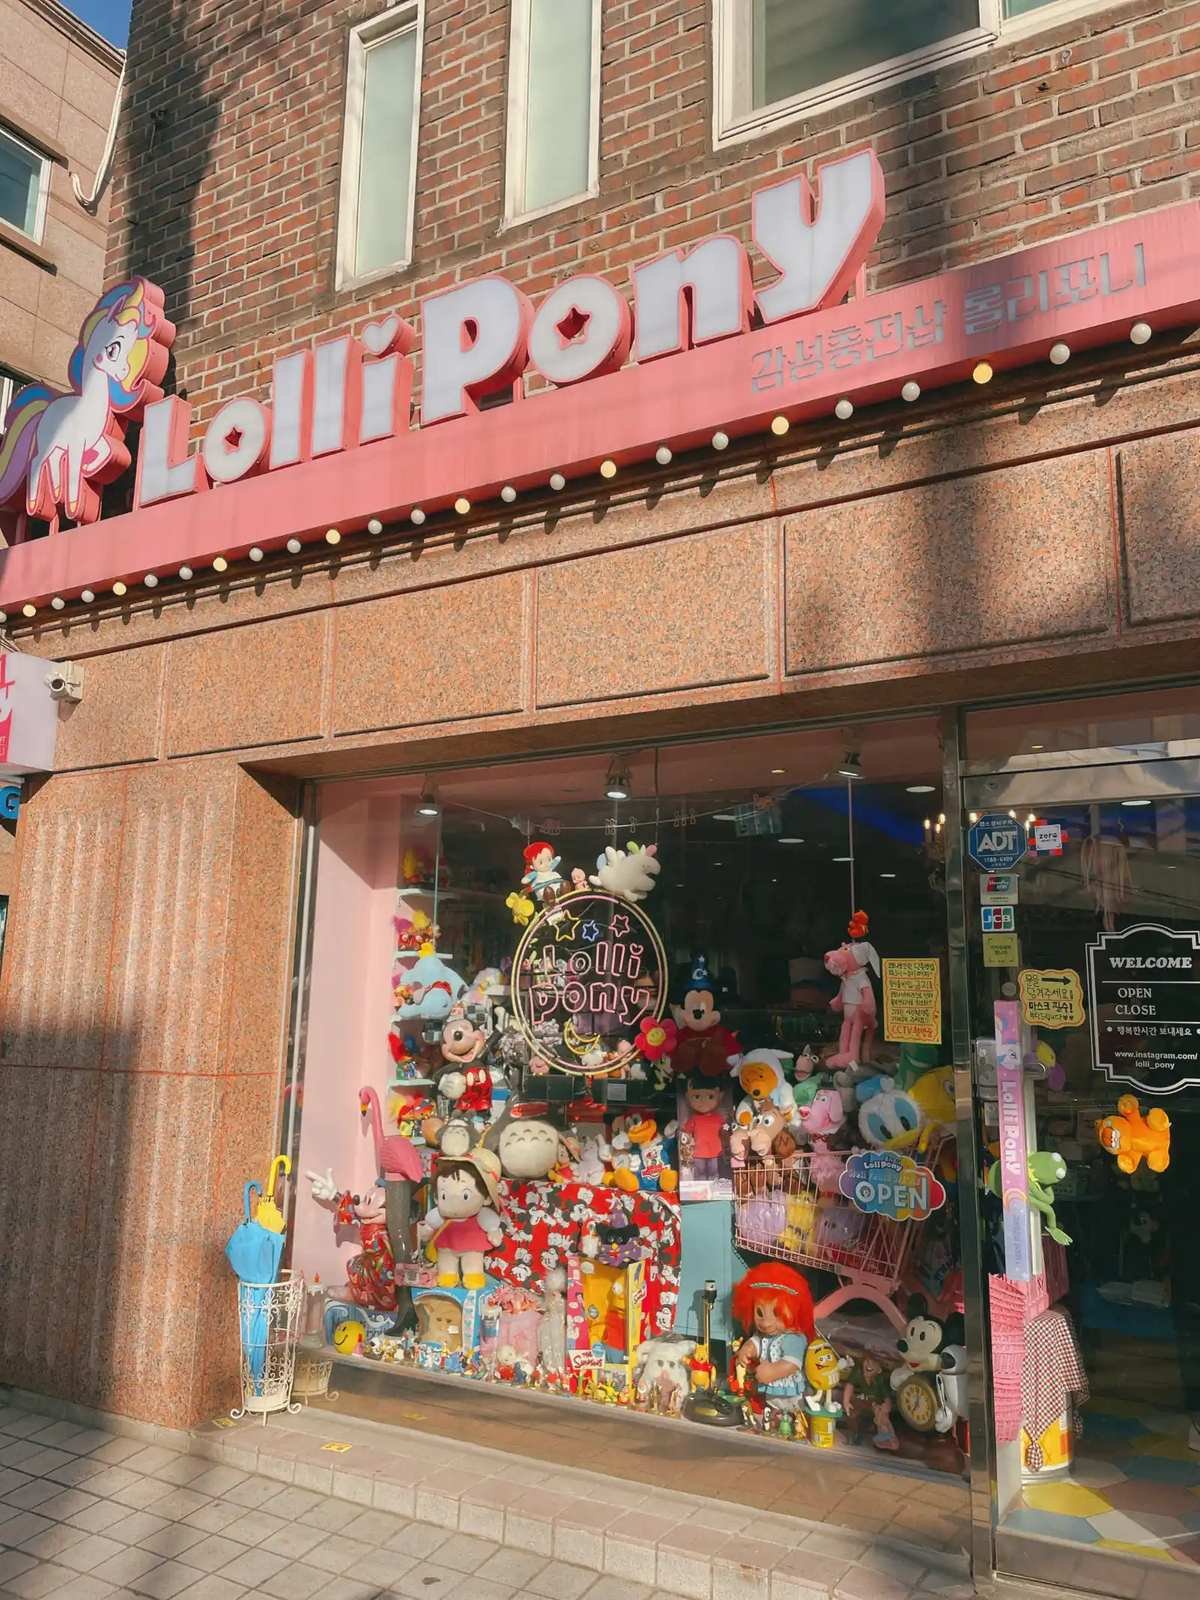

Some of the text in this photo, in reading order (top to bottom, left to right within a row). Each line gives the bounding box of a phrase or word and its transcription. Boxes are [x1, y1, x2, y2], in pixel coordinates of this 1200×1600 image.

[964, 242, 1148, 336] 롤리포니
[977, 829, 1018, 853] ADT
[982, 913, 1011, 923] JCB
[1109, 956, 1193, 969] WELCOME
[1117, 987, 1153, 999] OPEN
[1028, 1001, 1050, 1011] 마스크
[1115, 1003, 1157, 1016] CLOSE
[1114, 1050, 1198, 1061] www.instagram.com/
[1135, 1060, 1175, 1071] lolli_pony
[855, 1175, 927, 1211] OPEN
